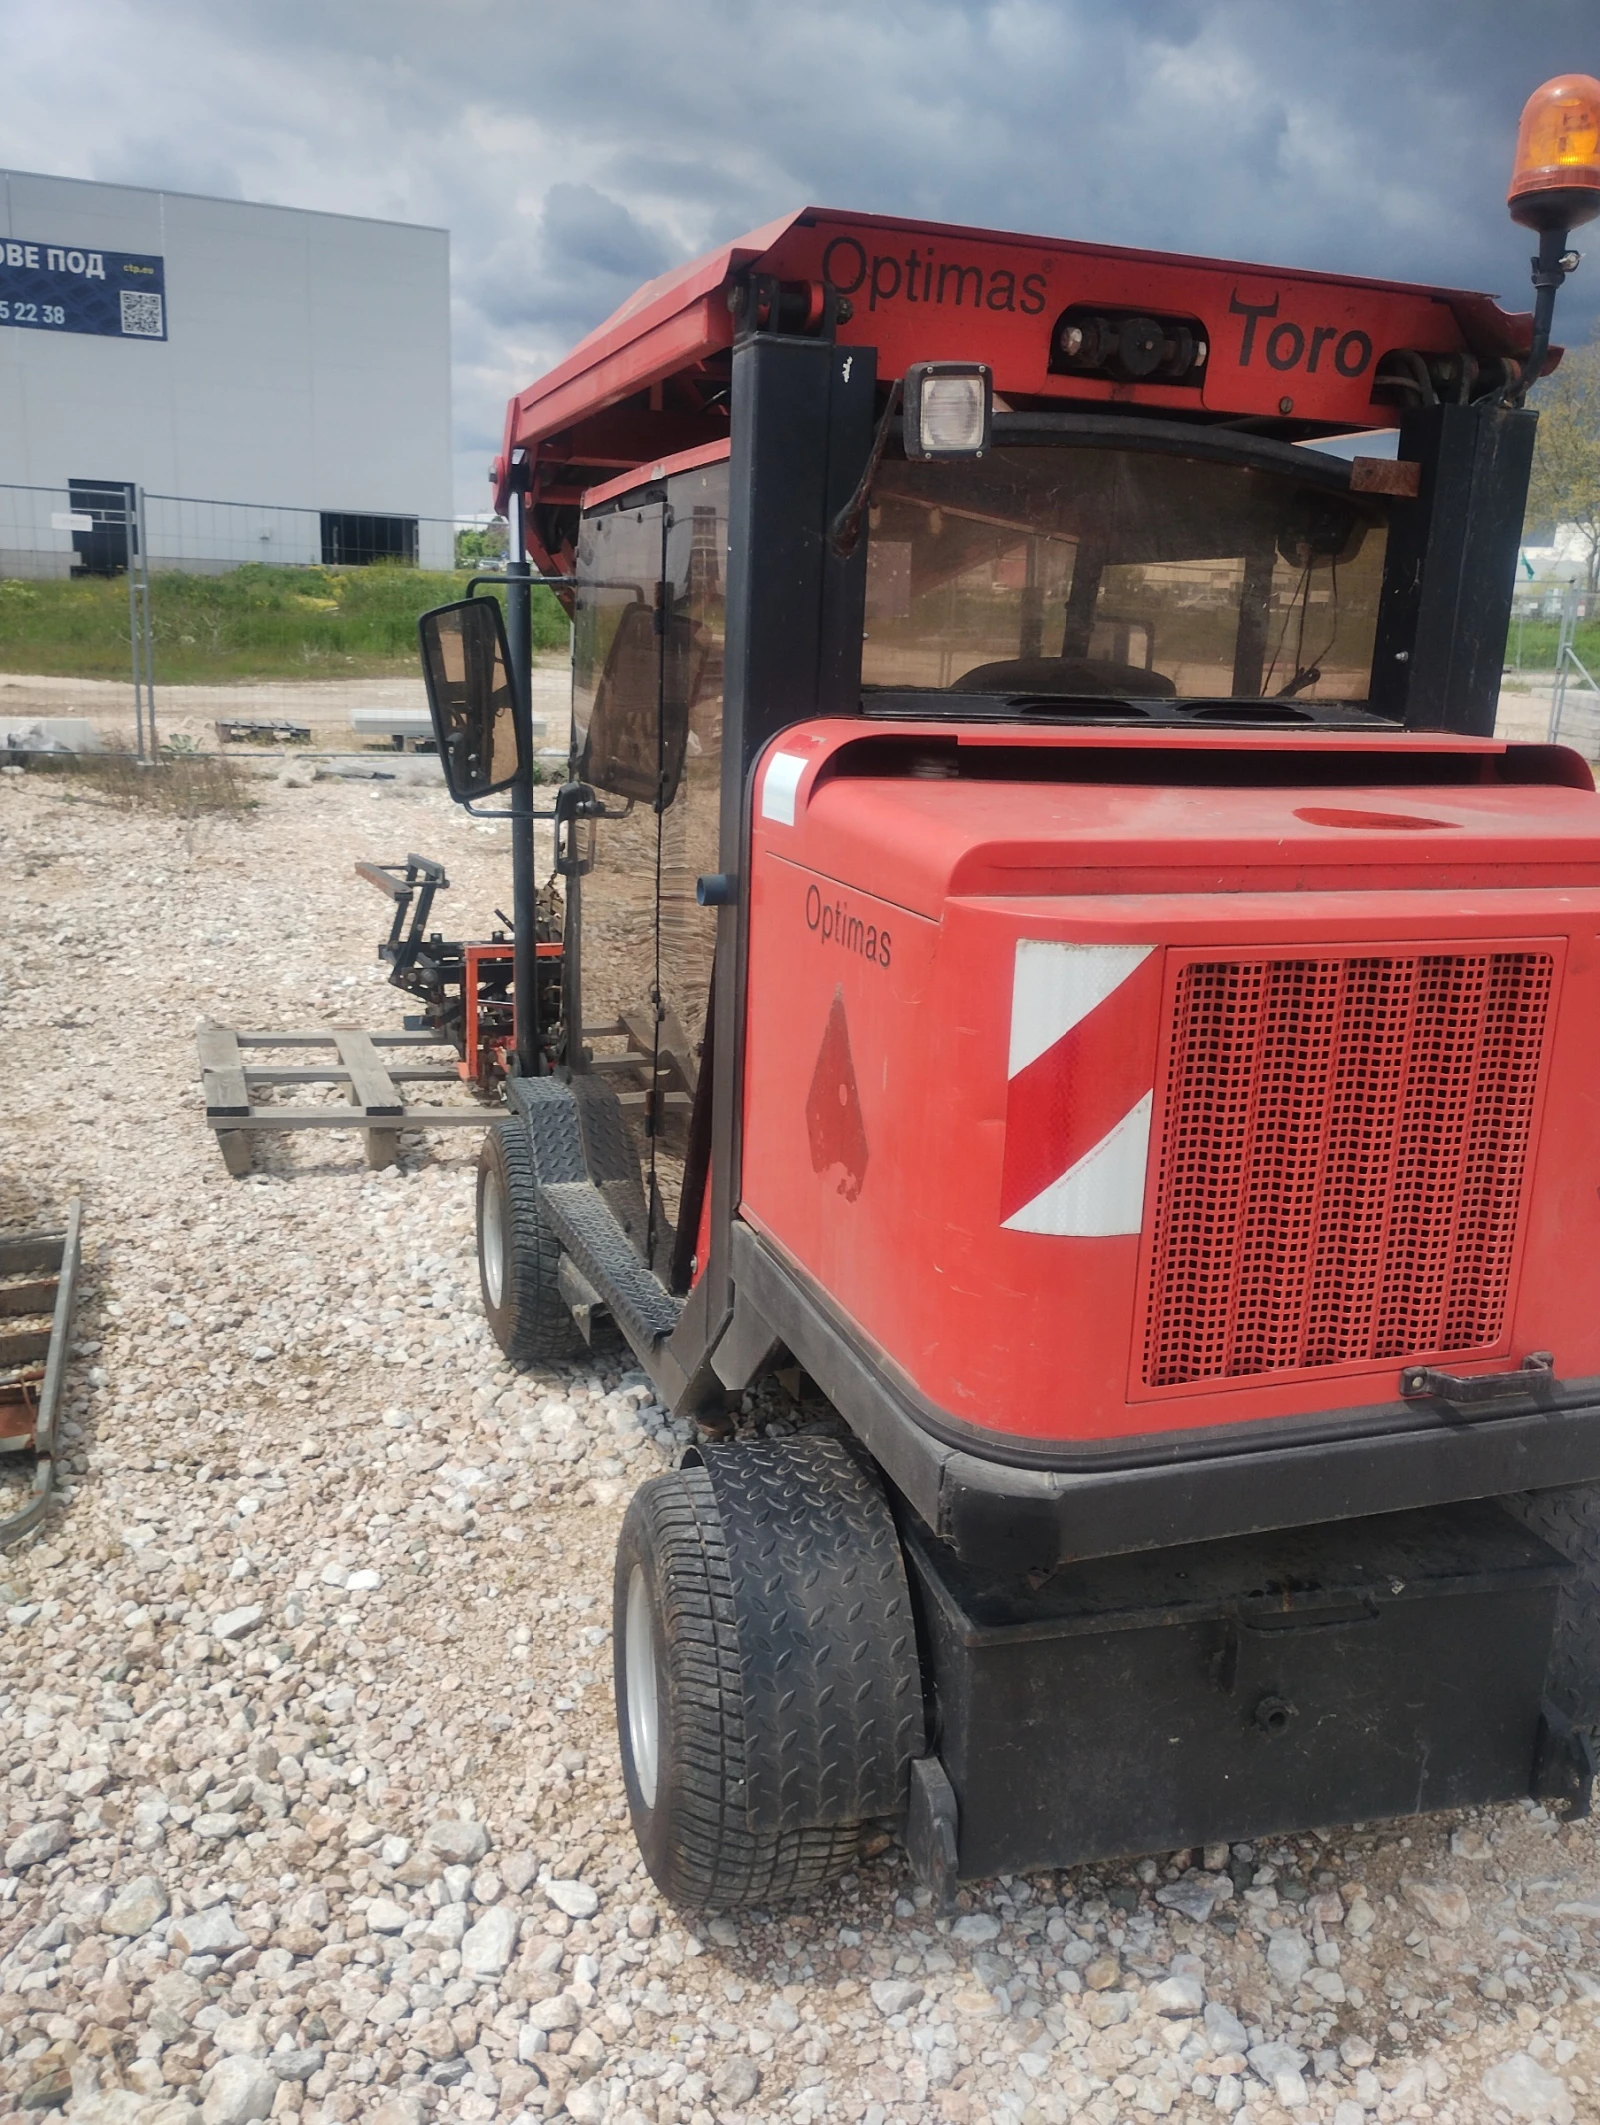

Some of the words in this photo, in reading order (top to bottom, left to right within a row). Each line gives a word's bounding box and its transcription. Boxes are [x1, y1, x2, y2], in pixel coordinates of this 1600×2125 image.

[47, 248, 106, 280] ПОД
[14, 302, 38, 321] 22
[42, 304, 65, 324] 38
[1228, 286, 1374, 378] Toro
[805, 884, 892, 968] Optimas
